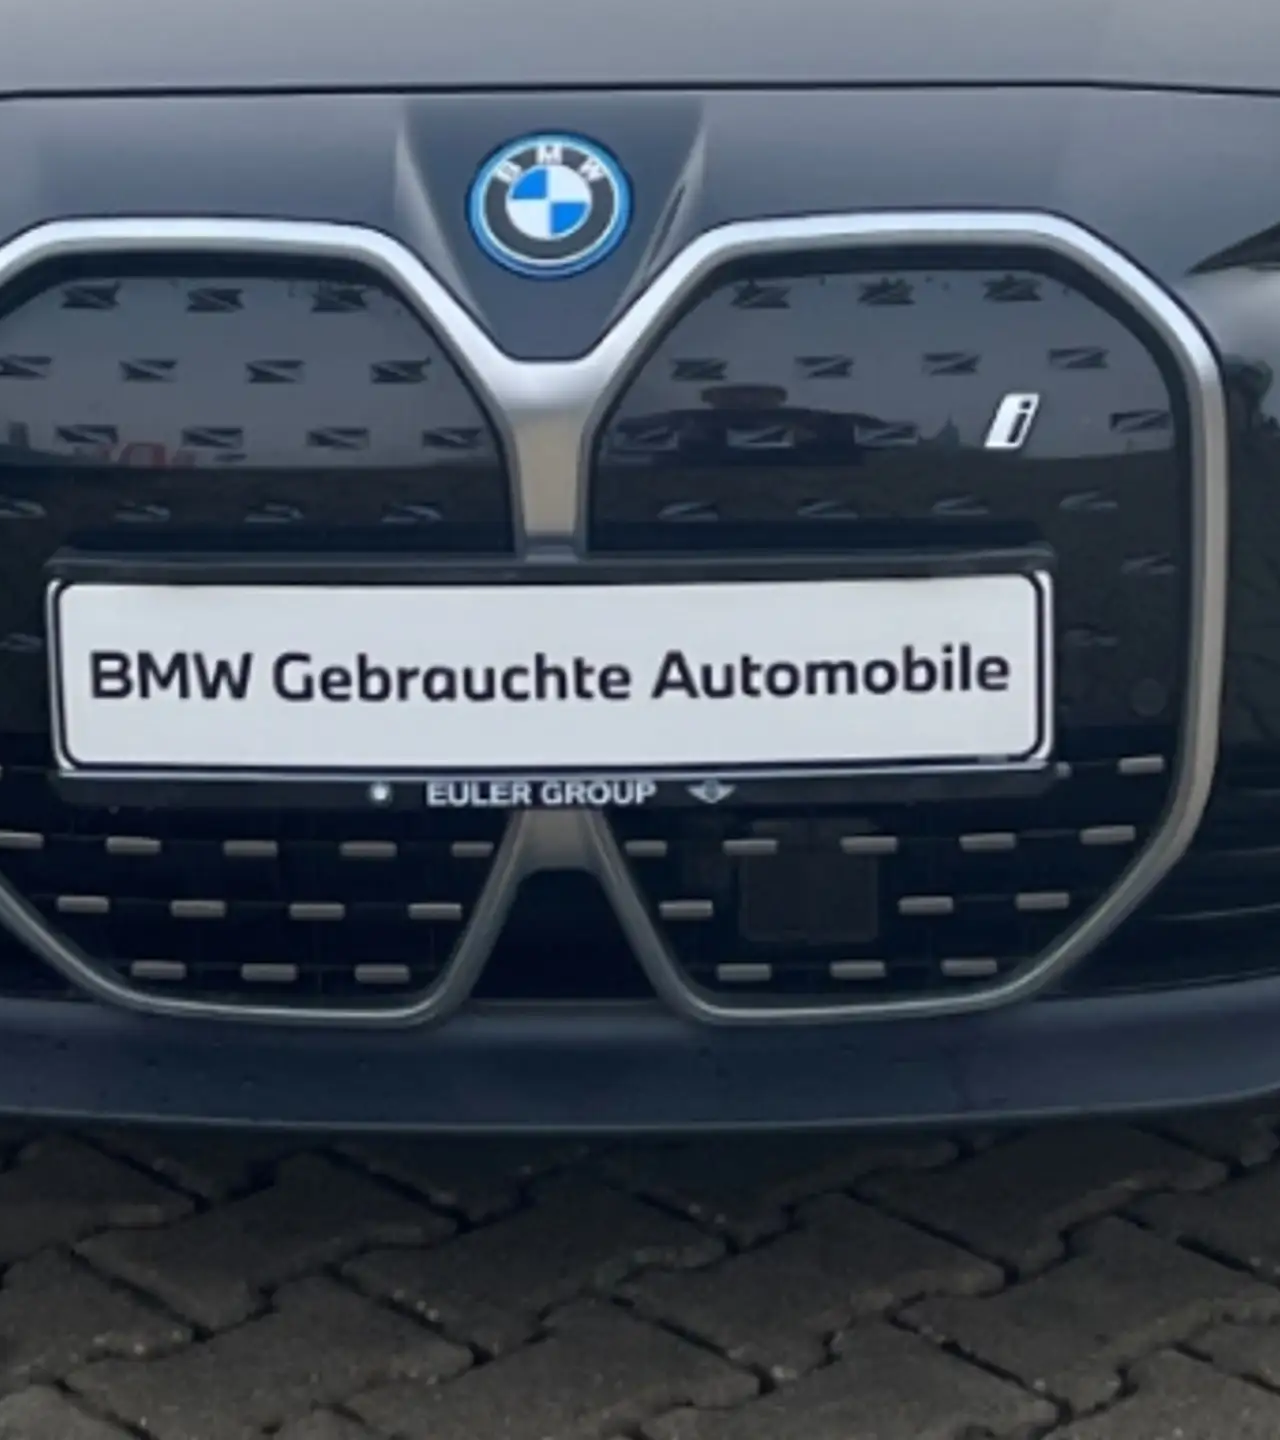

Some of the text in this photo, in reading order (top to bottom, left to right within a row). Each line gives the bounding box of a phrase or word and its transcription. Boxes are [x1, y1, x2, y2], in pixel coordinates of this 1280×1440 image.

[493, 143, 608, 184] BMW
[89, 642, 1011, 703] BMW Gebrauchte Automobile
[426, 779, 657, 807] EULER GROUP
